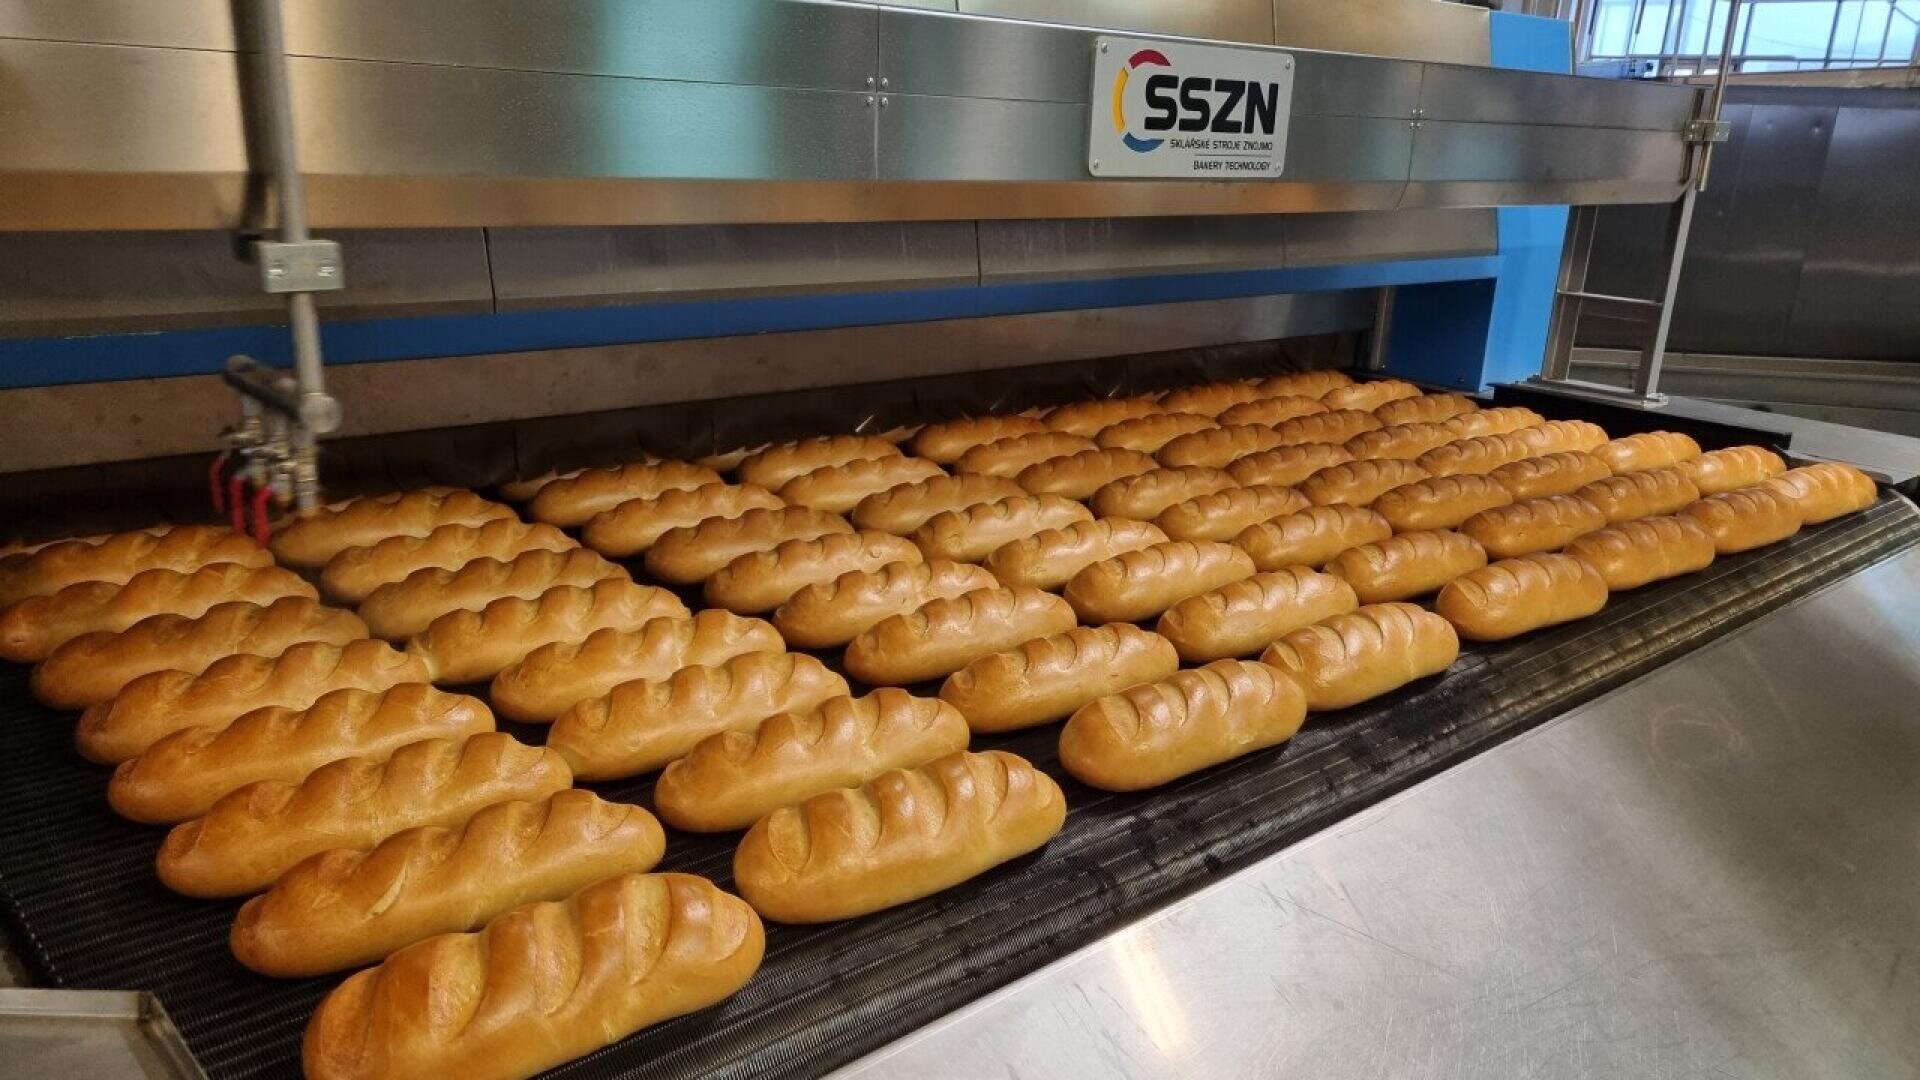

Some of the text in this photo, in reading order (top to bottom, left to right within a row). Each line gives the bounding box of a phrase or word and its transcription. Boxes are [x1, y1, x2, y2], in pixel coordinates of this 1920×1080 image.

[1144, 74, 1279, 135] SSZN
[1213, 140, 1241, 150] STROJE
[1243, 141, 1273, 151] ZNOJMO
[1193, 160, 1271, 171] BAKERY TECHNOLOGY
